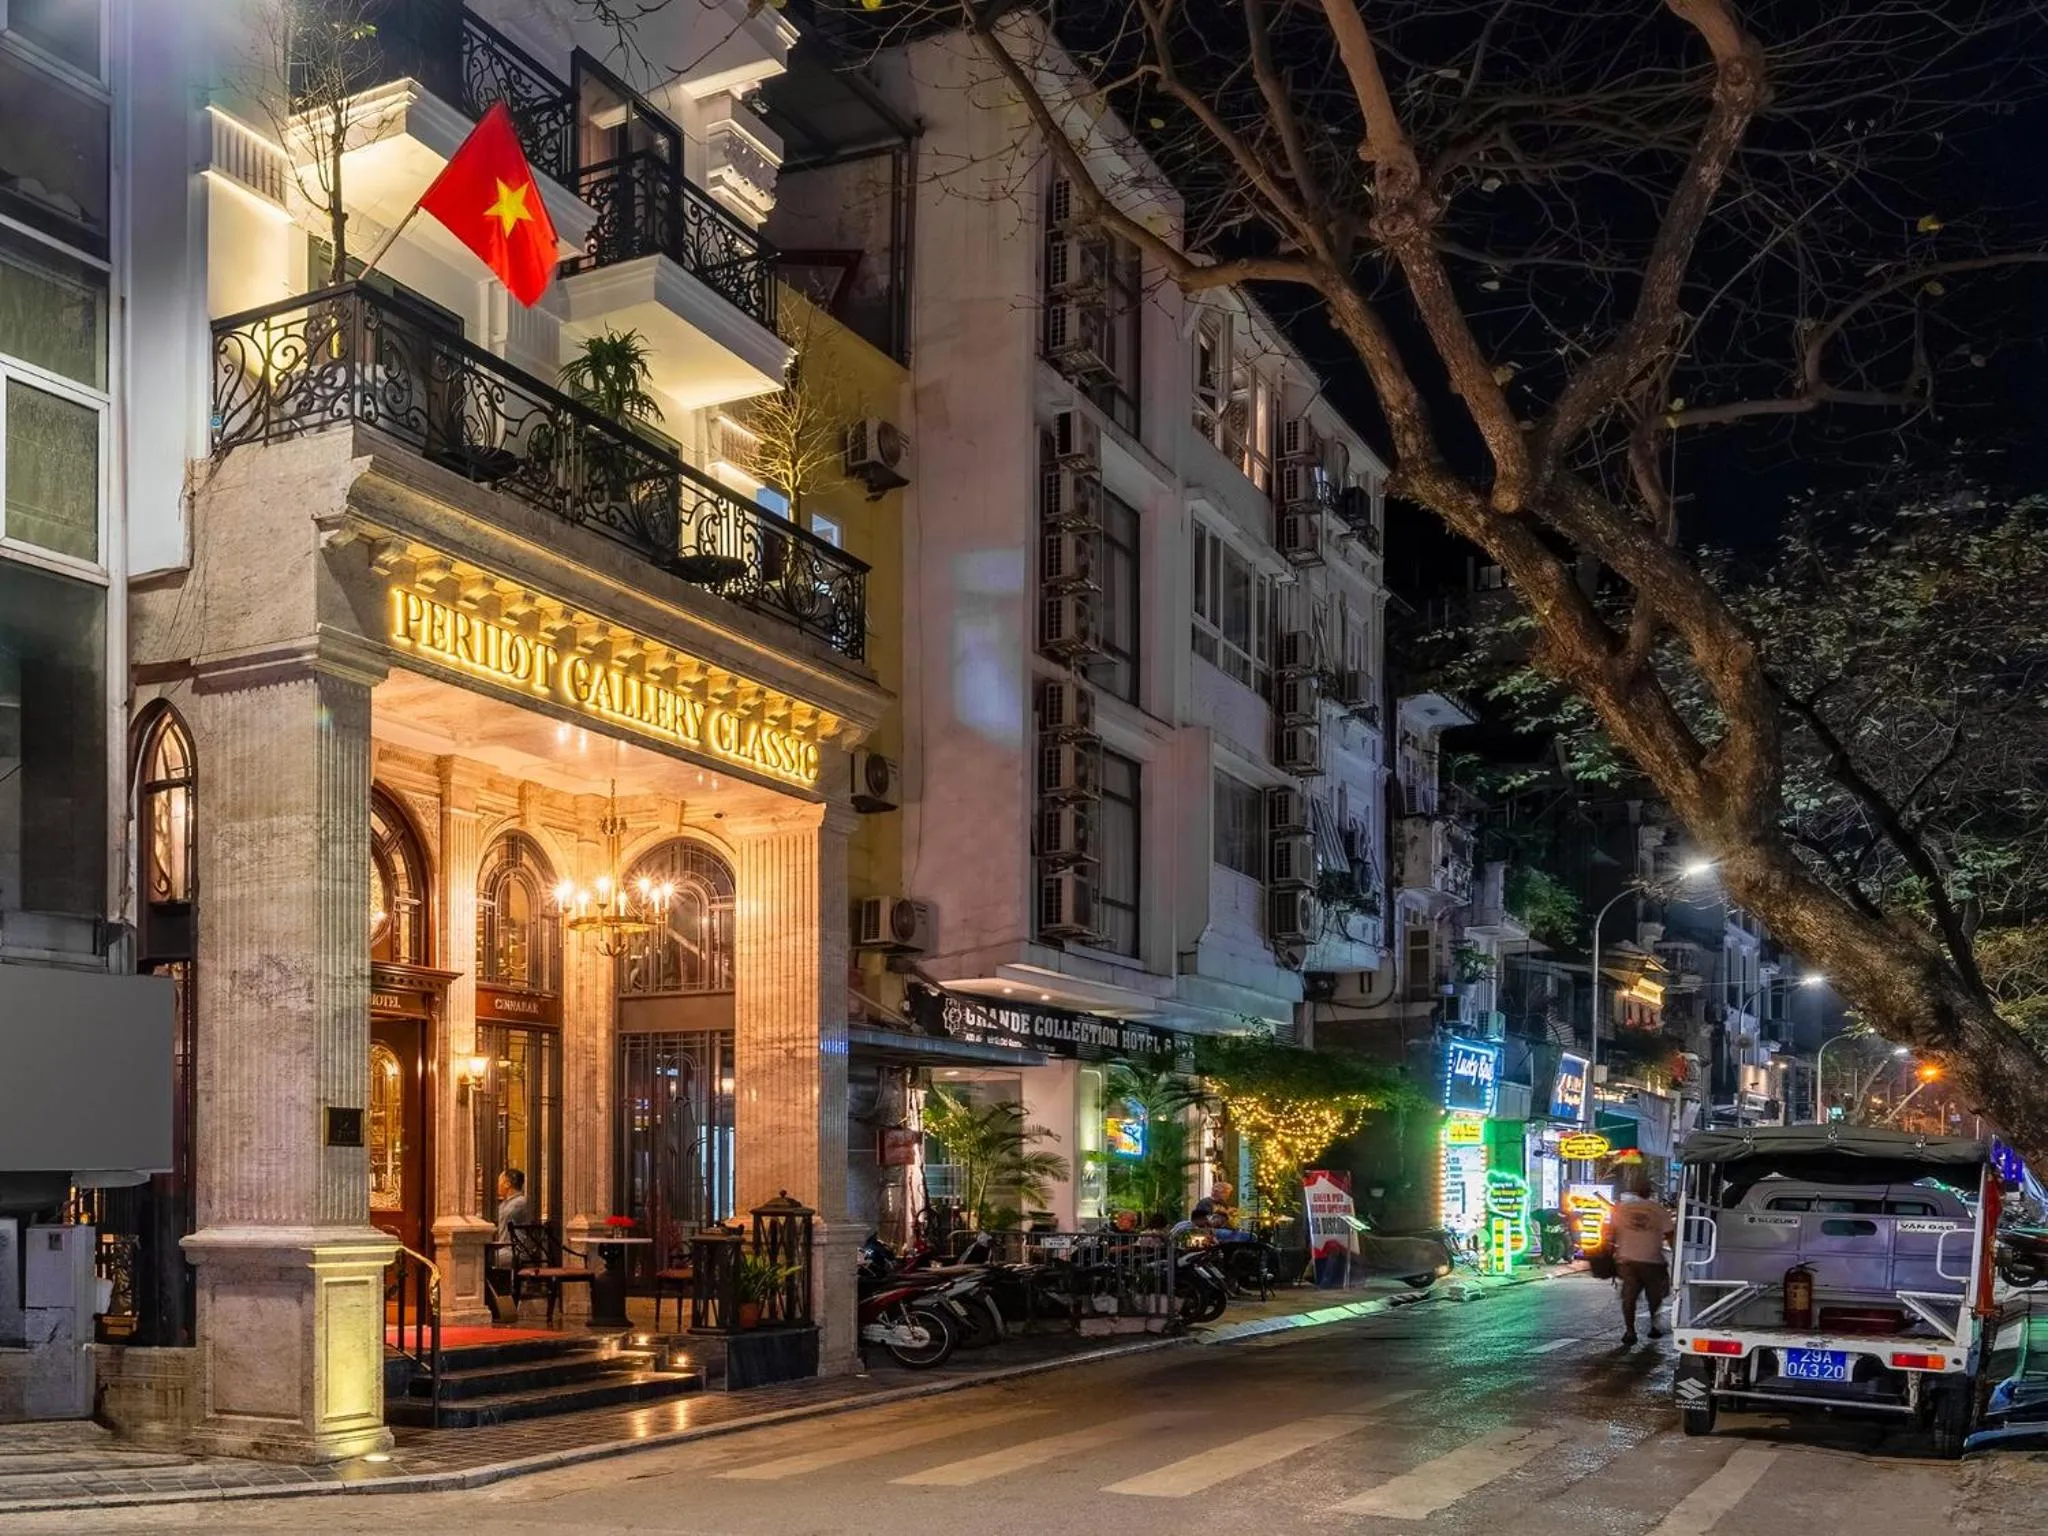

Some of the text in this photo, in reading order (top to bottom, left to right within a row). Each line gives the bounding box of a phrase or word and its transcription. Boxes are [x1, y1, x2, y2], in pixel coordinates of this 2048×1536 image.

[391, 587, 820, 784] PERIDOT GALLERY CLASSIC
[964, 1004, 1030, 1035] GRANDE
[1034, 1015, 1119, 1047] COLLECTION
[1121, 1030, 1161, 1054] HOTEL
[1800, 1349, 1832, 1363] 29A
